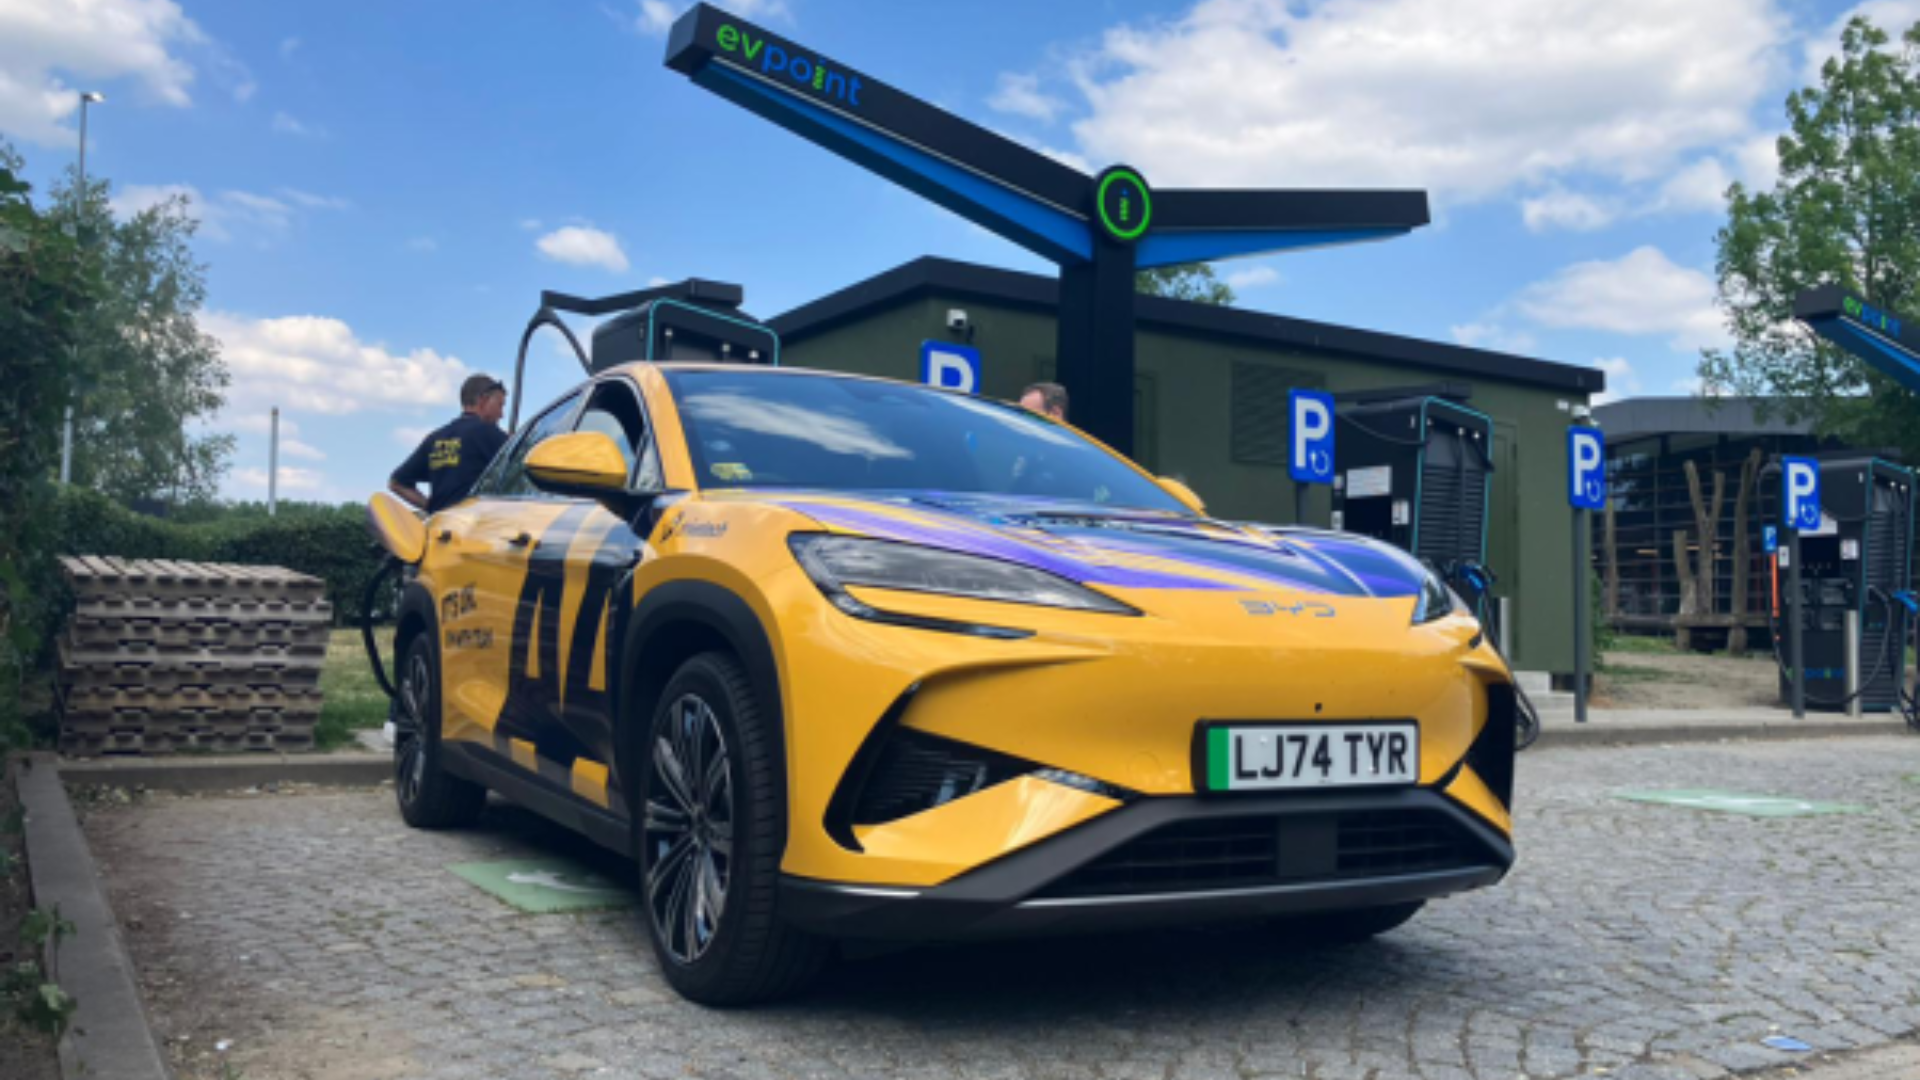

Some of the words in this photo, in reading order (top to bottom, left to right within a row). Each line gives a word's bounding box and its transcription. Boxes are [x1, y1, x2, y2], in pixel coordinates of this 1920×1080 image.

[716, 24, 863, 105] evpoint
[1296, 396, 1329, 467] P
[1574, 434, 1601, 495] P
[1788, 463, 1816, 520] P
[1235, 734, 1332, 779] LJ74
[1344, 732, 1408, 775] TYR
